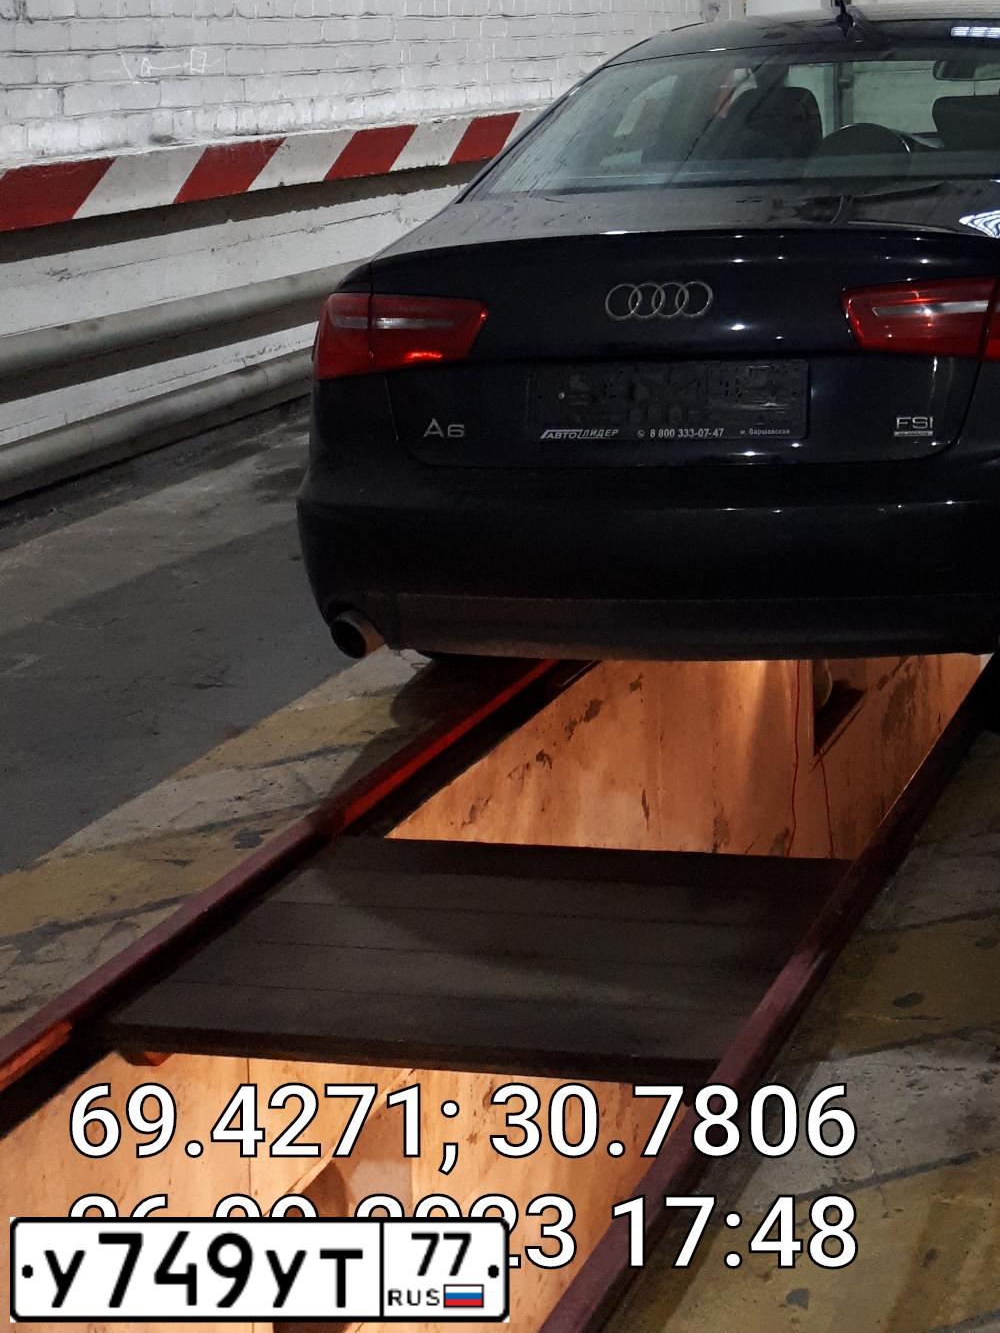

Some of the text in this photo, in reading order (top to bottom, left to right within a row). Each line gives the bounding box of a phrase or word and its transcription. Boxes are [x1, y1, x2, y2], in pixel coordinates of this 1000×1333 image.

[423, 418, 464, 437] A6
[896, 416, 933, 429] FSI
[650, 428, 656, 438] 8
[678, 427, 725, 438] 333-07-47
